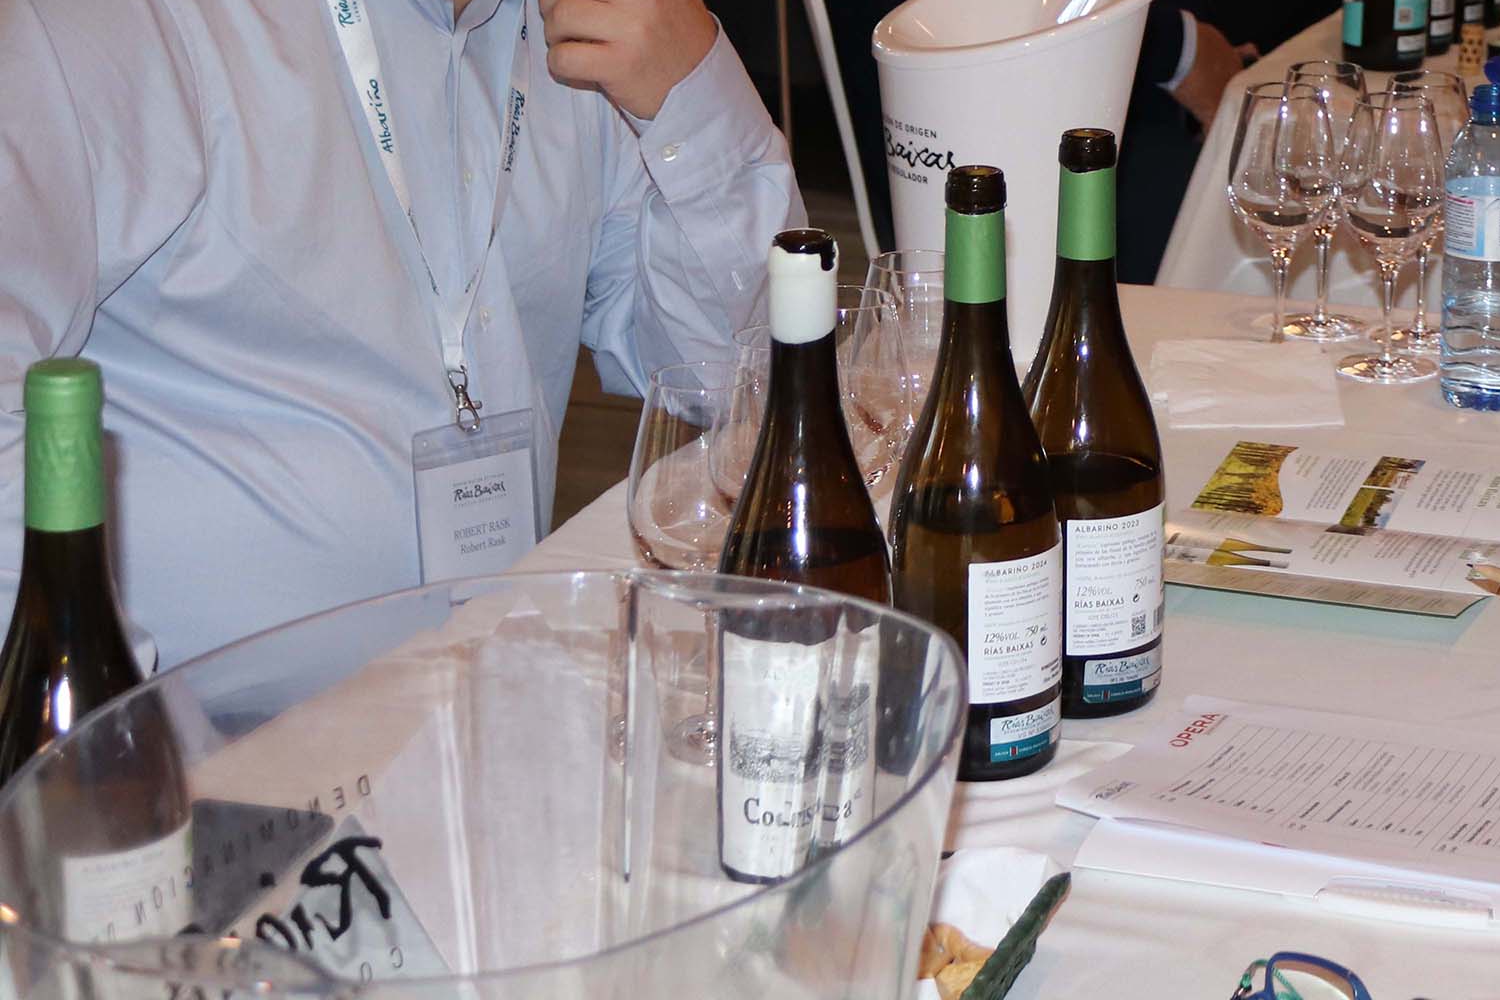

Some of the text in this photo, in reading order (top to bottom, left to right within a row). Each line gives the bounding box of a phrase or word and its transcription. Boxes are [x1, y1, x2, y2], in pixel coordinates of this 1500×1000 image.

[366, 78, 394, 154] Albariño
[904, 123, 937, 139] ORIGEN
[454, 519, 510, 539] ROBERT RASK
[461, 537, 506, 554] Robert Rask
[1095, 596, 1125, 608] BAIXAS
[1006, 641, 1034, 654] BAIXAS
[1168, 713, 1221, 747] OPERA
